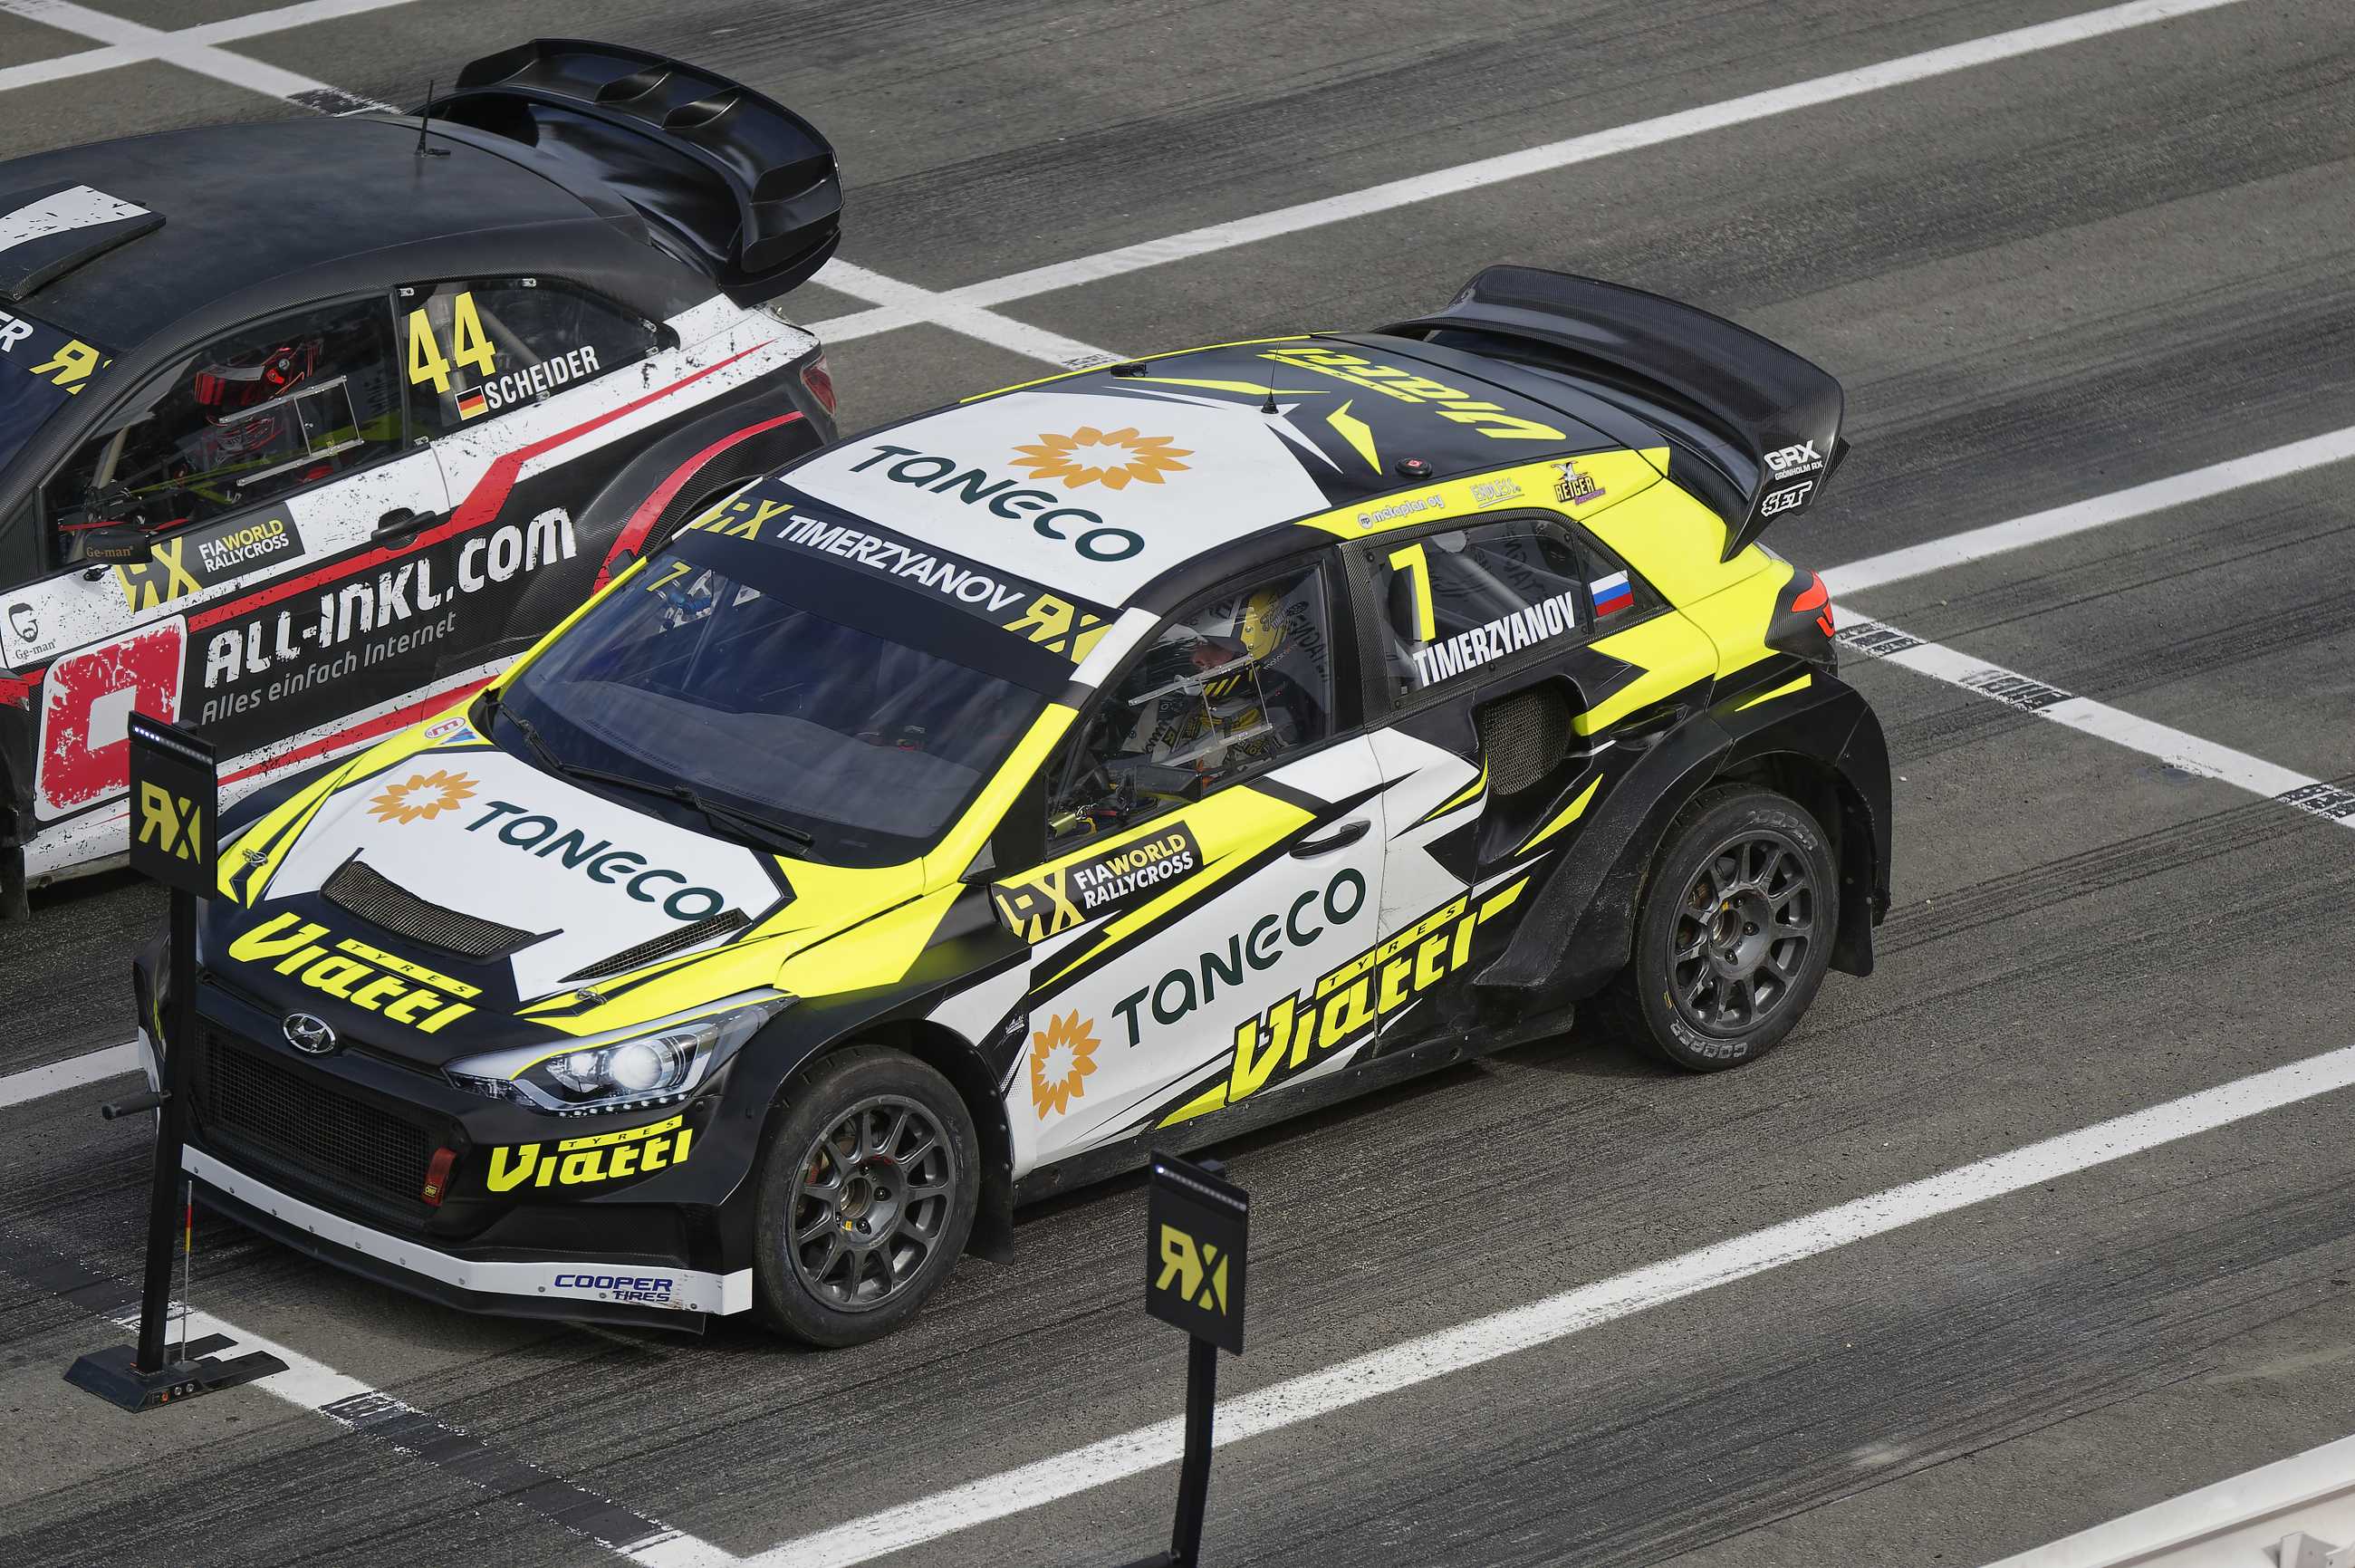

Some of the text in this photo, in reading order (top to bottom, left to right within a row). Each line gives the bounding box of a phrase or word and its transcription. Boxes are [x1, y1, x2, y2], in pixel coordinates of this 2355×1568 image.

[409, 292, 496, 393] 44
[487, 345, 601, 409] SCHEIDER
[1764, 439, 1822, 471] GRX
[1812, 460, 1823, 470] RX
[1372, 500, 1427, 523] metaplan
[1427, 494, 1445, 508] oy
[1470, 477, 1518, 502] ENDLESS
[1553, 476, 1596, 503] REIGER
[1761, 480, 1812, 517] SET
[204, 533, 290, 572] RALLYCROSS
[776, 515, 1025, 613] TIMERZYANOV
[646, 562, 692, 592] 7
[1412, 592, 1575, 688] TIMERZYANOV
[201, 611, 457, 726] Alles einfach Internet
[1083, 851, 1194, 909] RALLYCROSS
[351, 944, 467, 993] TYRES
[1329, 906, 1456, 987] TYRES
[228, 911, 477, 1034] Viatti
[1227, 913, 1478, 1103] Viatti
[568, 1121, 674, 1148] TYRES
[486, 1129, 694, 1192] Viatti
[554, 1275, 674, 1293] COOPER
[612, 1290, 672, 1303] TIRES
